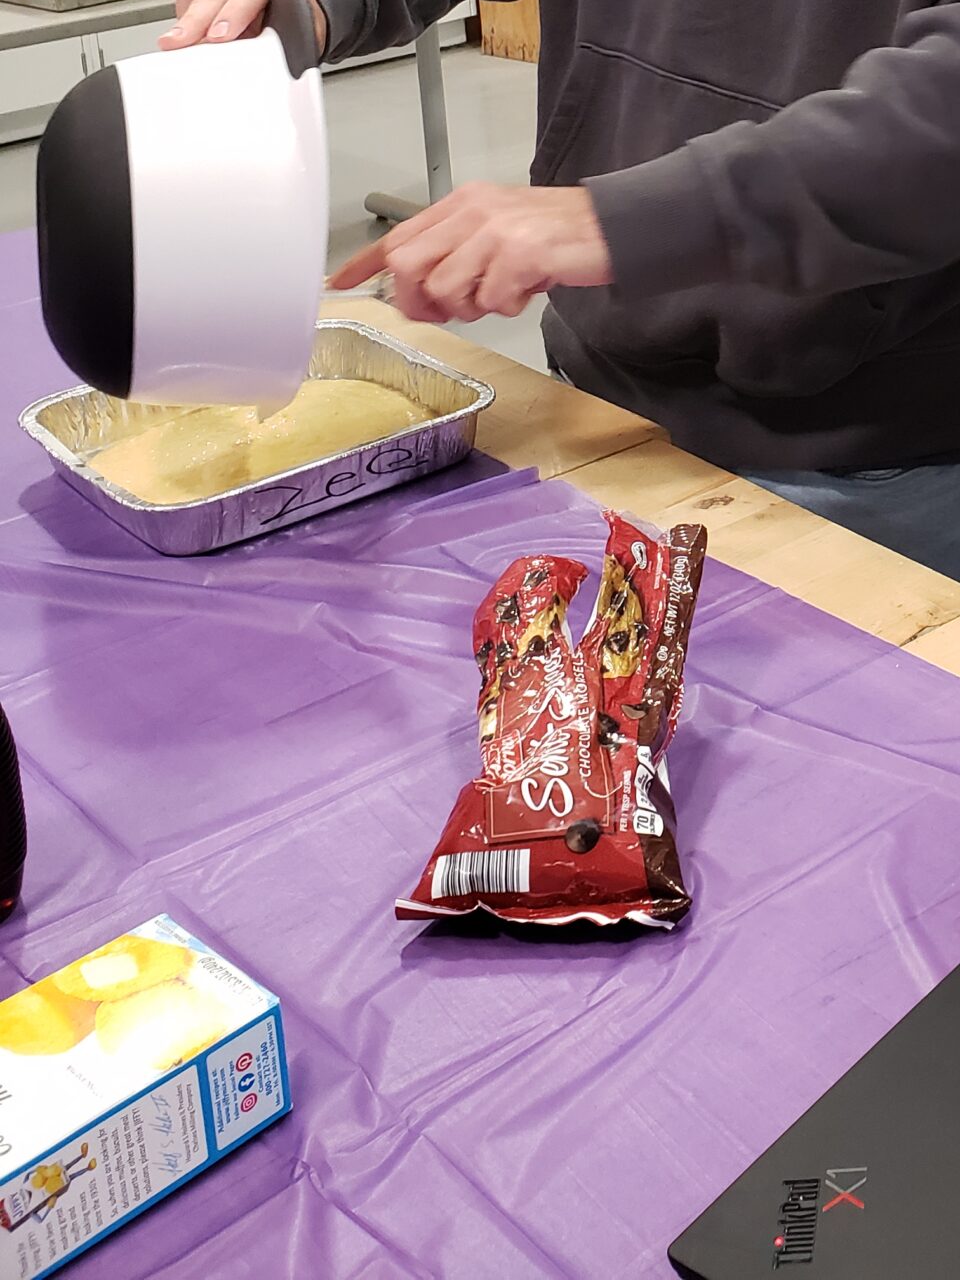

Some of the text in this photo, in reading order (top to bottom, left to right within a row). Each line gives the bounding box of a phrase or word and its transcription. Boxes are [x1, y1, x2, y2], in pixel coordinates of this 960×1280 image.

[666, 604, 678, 619] WT
[572, 649, 592, 778] CHOCOLATE MORSELS
[636, 815, 649, 830] 70
[822, 1166, 868, 1212] X1
[773, 1179, 821, 1269] ThinkPad
